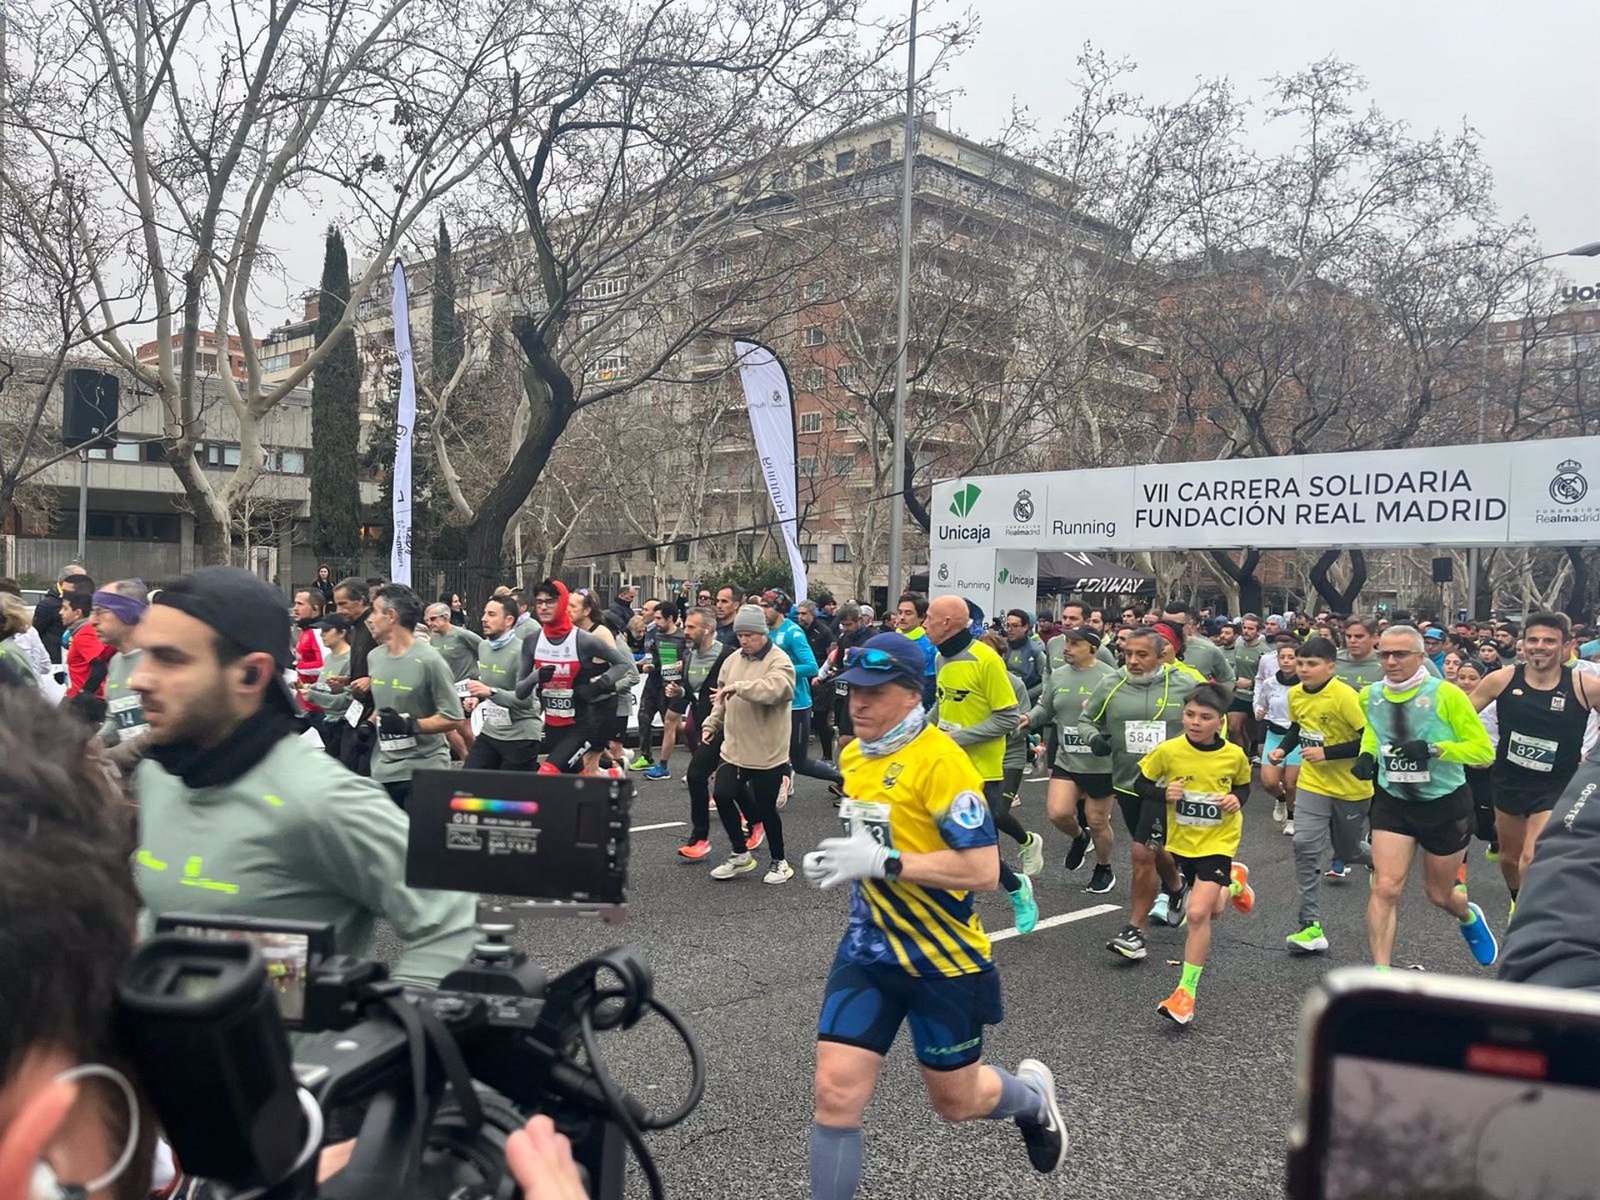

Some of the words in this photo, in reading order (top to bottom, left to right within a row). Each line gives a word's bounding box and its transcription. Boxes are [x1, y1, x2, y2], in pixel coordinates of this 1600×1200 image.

[1143, 483, 1168, 503] VII
[1178, 477, 1300, 502] CARRERA
[1309, 469, 1472, 497] SOLIDARIA
[1135, 501, 1286, 528] FUNDACIÓN
[1295, 503, 1366, 525] REAL
[1376, 498, 1507, 523] MADRID
[1536, 513, 1600, 523] Realmadrid
[939, 524, 991, 543] Unicaja
[1052, 520, 1116, 537] Running
[957, 579, 991, 591] Running
[1009, 574, 1035, 588] Unicaja
[1073, 577, 1144, 593] CONWAY
[546, 698, 572, 709] 1580
[1128, 730, 1161, 744] 5841
[1516, 745, 1547, 760] 827
[1390, 758, 1418, 771] 608
[1180, 801, 1218, 818] 1510
